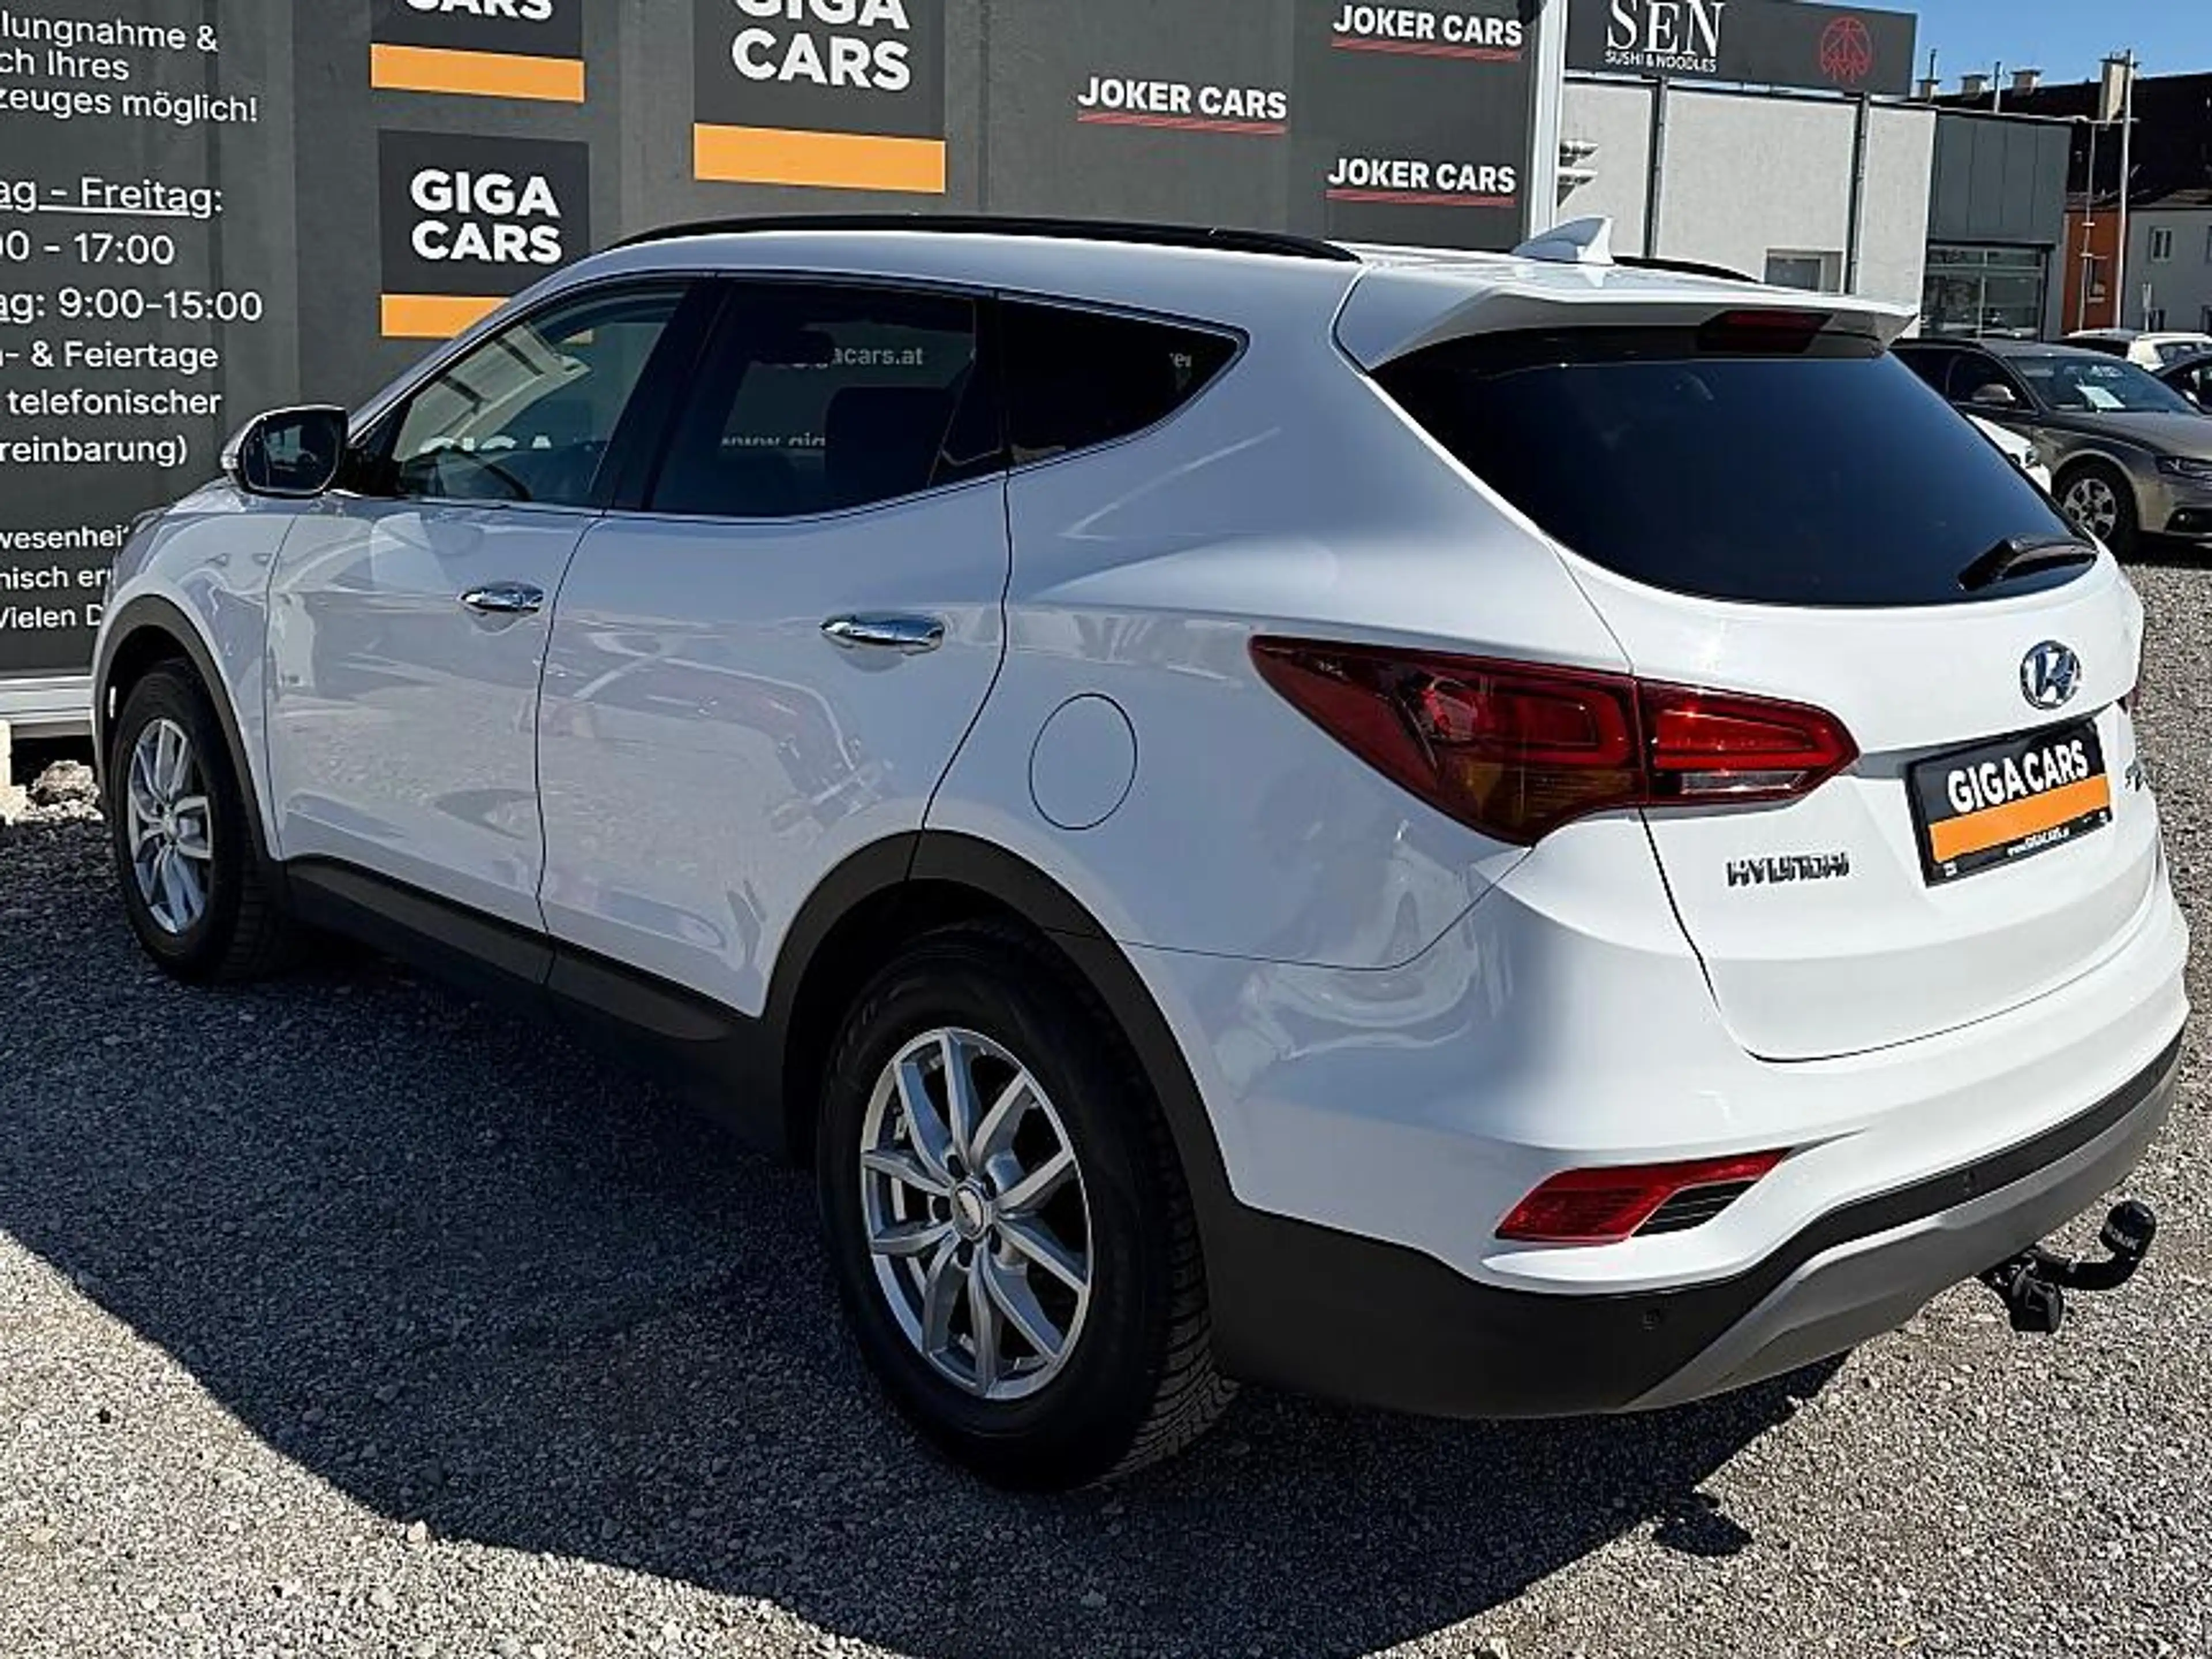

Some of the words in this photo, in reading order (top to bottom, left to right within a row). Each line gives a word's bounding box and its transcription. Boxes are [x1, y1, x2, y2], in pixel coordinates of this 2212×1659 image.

[2, 10, 185, 48] lungnahme
[196, 25, 218, 51] &
[1333, 5, 1435, 40] JOKER
[1442, 14, 1522, 47] CARS
[1606, 0, 1725, 57] SEN
[48, 50, 129, 80] Ihres
[732, 28, 910, 90] CARS
[1605, 50, 1644, 65] SUSHI
[1646, 53, 1655, 67] &
[1656, 54, 1717, 73] NOODLES
[122, 91, 257, 125] möglich!
[1078, 77, 1191, 113] JOKER
[1198, 86, 1286, 119] CARS
[411, 169, 560, 217] GIGA
[1327, 158, 1429, 189] JOKER
[1435, 164, 1516, 193] CARS
[81, 177, 222, 218] Freitag:
[74, 233, 175, 264] 17:00
[412, 221, 562, 264] CARS
[59, 287, 262, 321] 9:00-15:00
[31, 340, 54, 367] &
[65, 340, 218, 374] Feiertage
[7, 389, 221, 415] telefonischer
[0, 435, 187, 467] reinbarung)
[1948, 757, 2028, 813] GIGA
[2022, 739, 2090, 792] CARS
